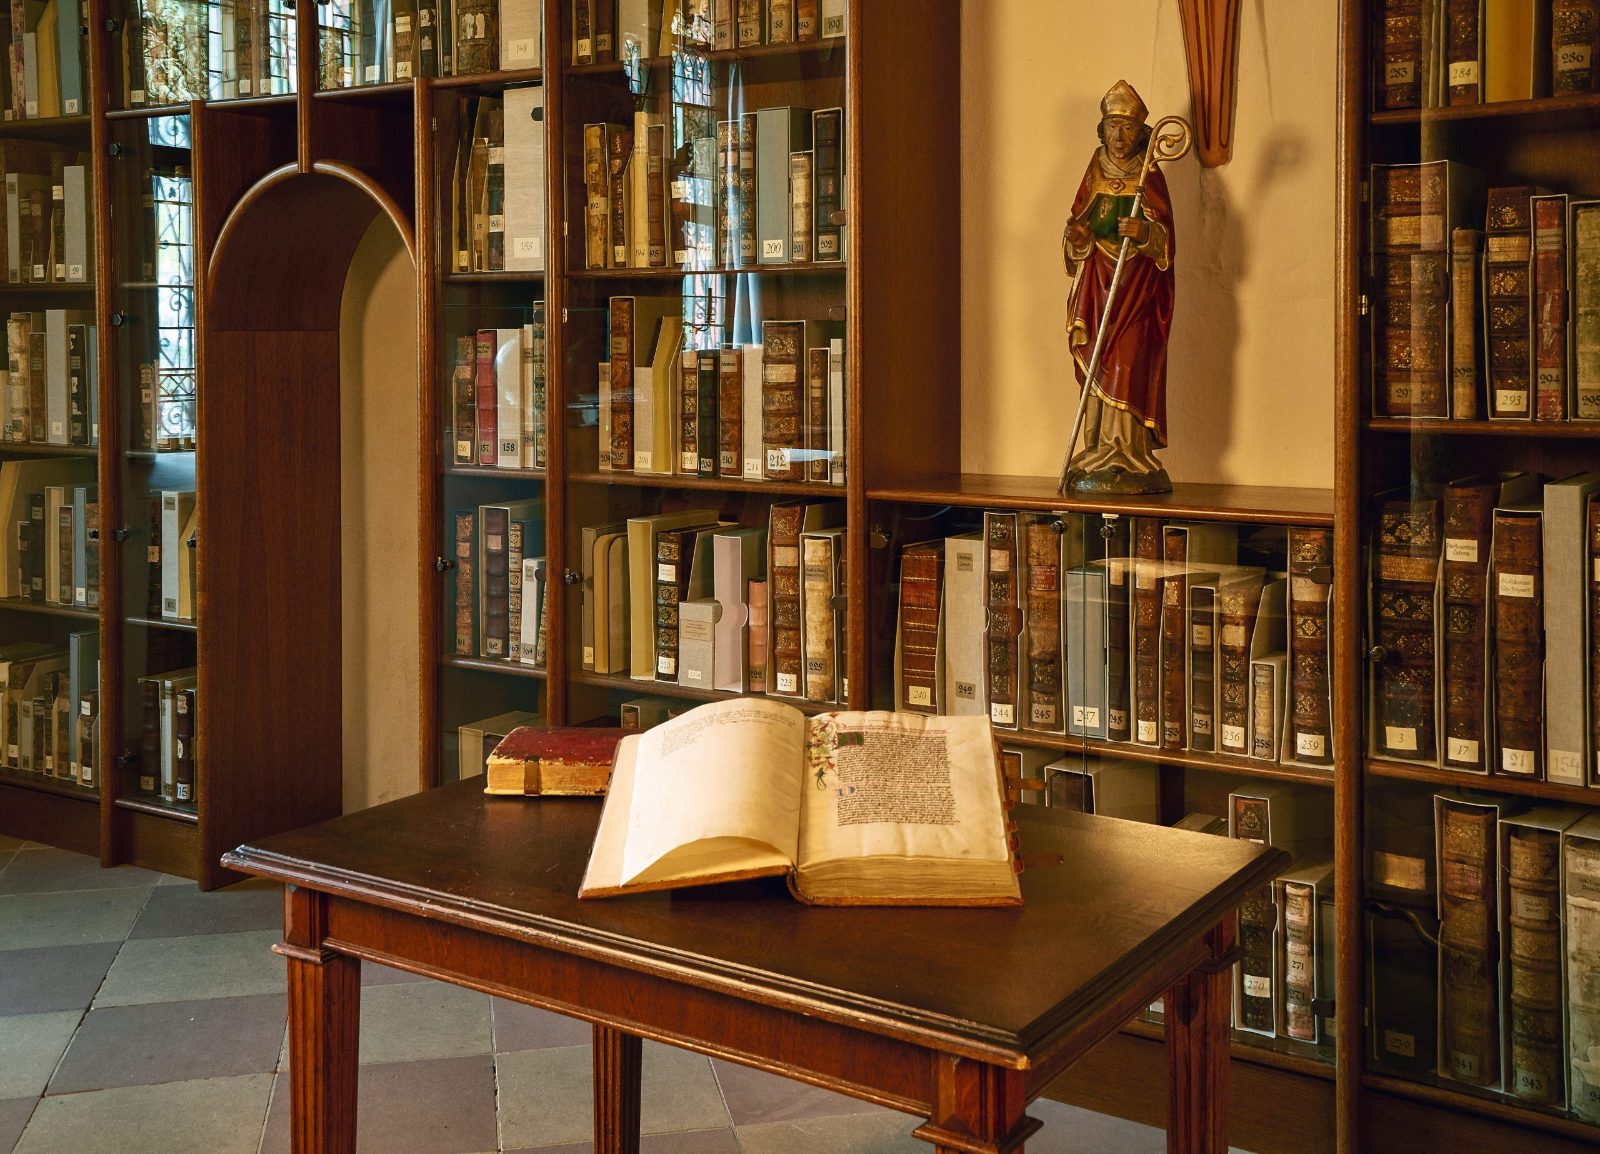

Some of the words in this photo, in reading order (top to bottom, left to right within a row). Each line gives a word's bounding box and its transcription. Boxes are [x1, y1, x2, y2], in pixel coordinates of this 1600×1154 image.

[1561, 53, 1585, 63] 286
[1453, 67, 1472, 80] 284
[1539, 373, 1560, 385] 294
[1502, 395, 1522, 406] 293
[503, 443, 515, 452] 158
[769, 453, 786, 468] 212
[780, 678, 793, 688] 223
[913, 690, 928, 700] 240
[993, 707, 1010, 718] 244
[1034, 709, 1052, 720] 245
[1193, 718, 1210, 730] 254
[1224, 730, 1240, 742] 256
[1397, 733, 1405, 744] 3
[1301, 739, 1320, 751] 259
[1456, 744, 1470, 756] 17
[1510, 753, 1526, 768] 21
[1554, 755, 1582, 777] 154
[1291, 960, 1305, 971] 271
[1247, 980, 1266, 991] 270
